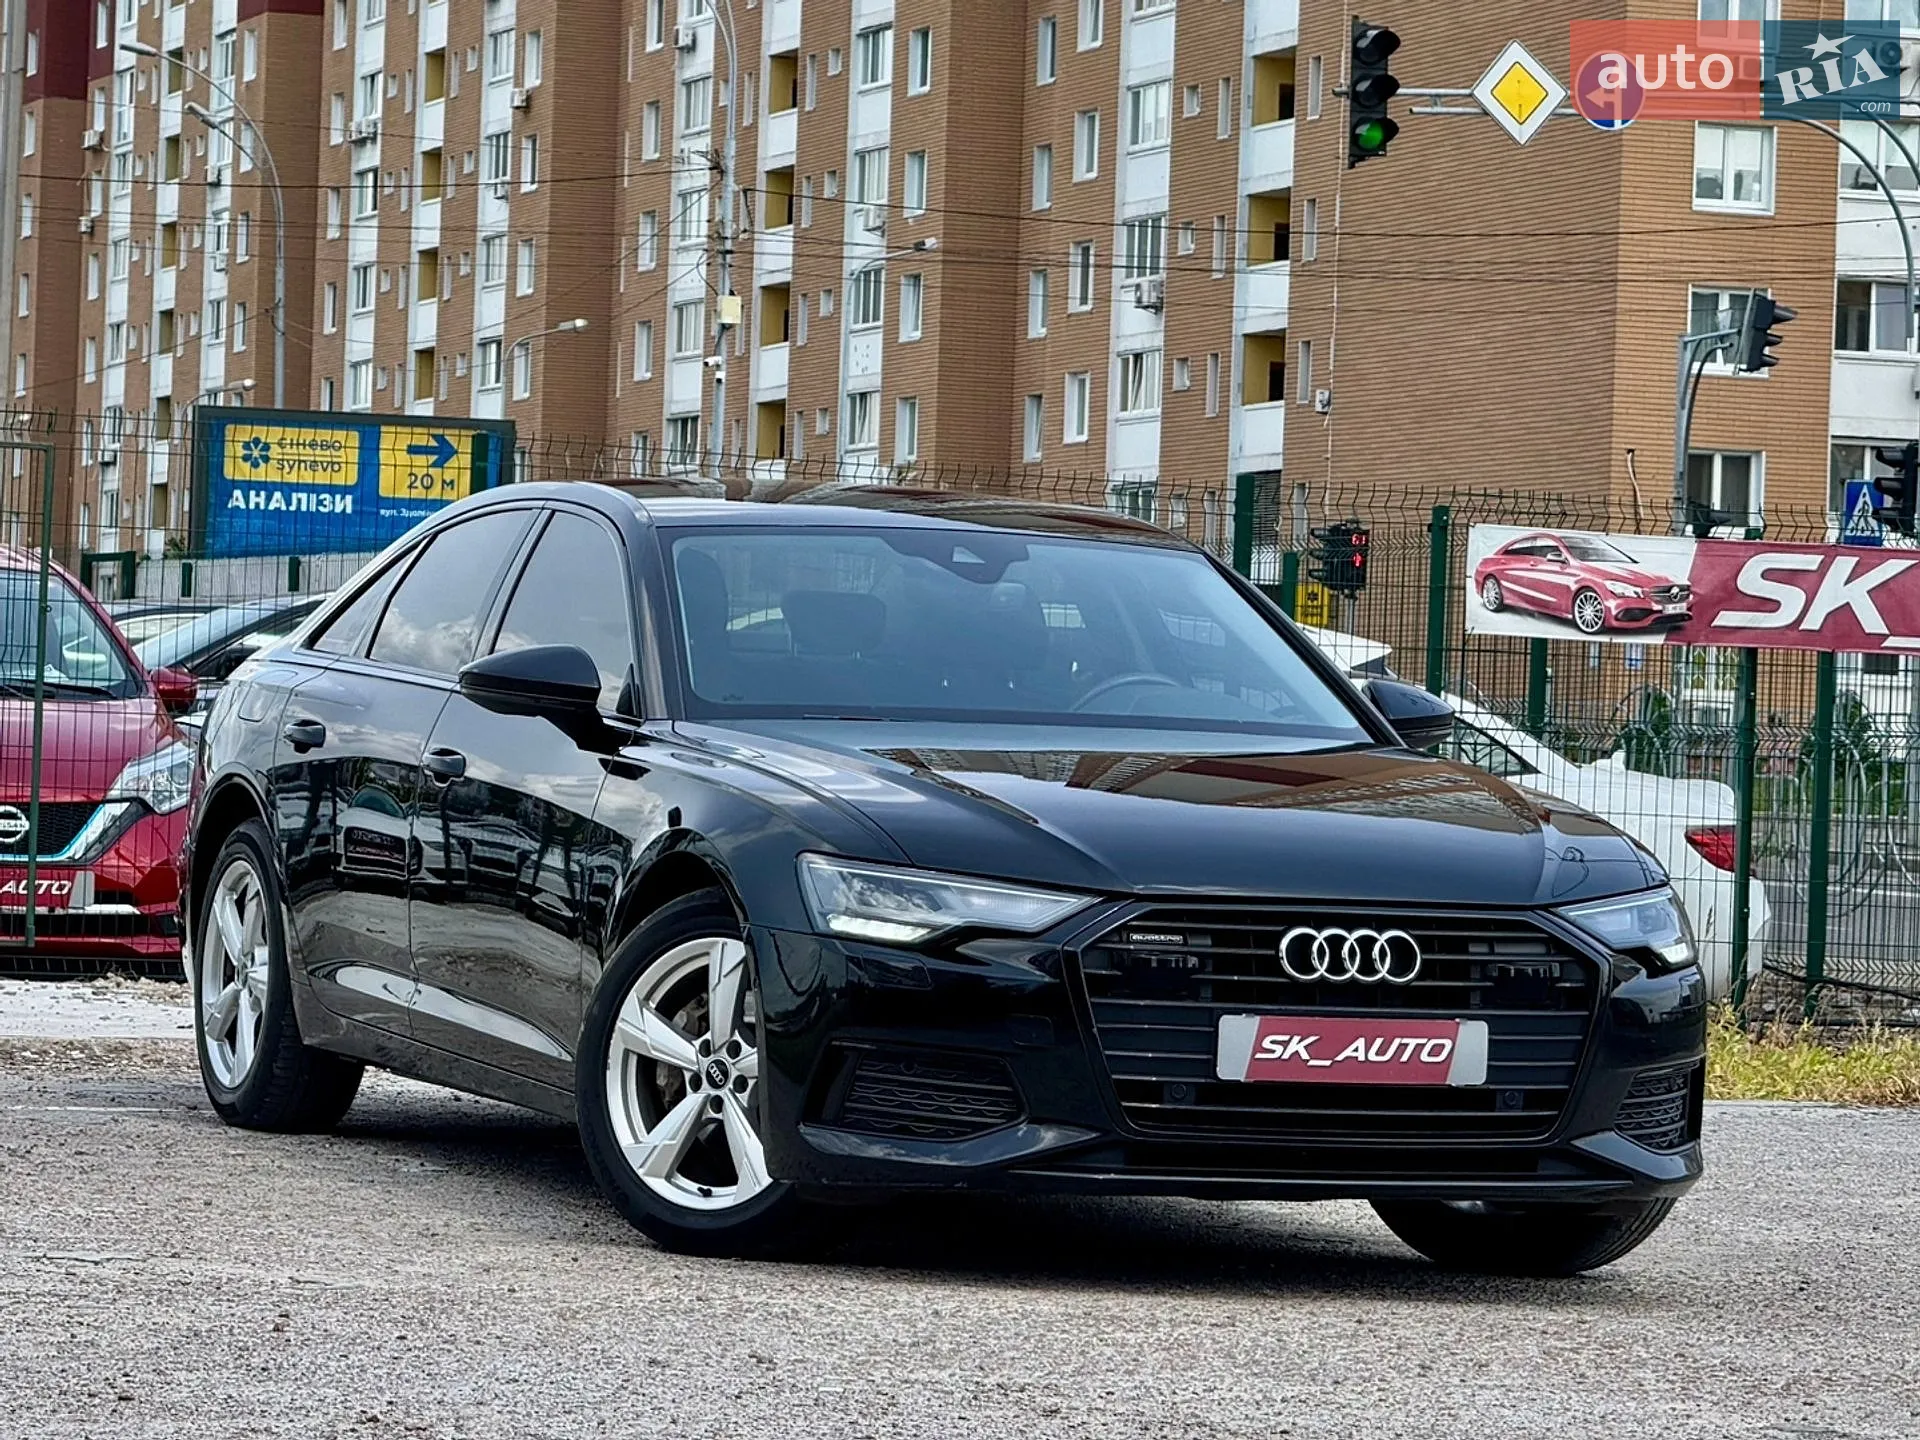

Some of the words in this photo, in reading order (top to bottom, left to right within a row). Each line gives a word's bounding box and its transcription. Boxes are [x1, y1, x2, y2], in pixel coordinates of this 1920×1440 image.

[276, 459, 342, 475] synevo
[407, 472, 434, 490] 20
[227, 489, 353, 514] АНАЛІЗИ
[1254, 1034, 1453, 1067] SK_AUTO
